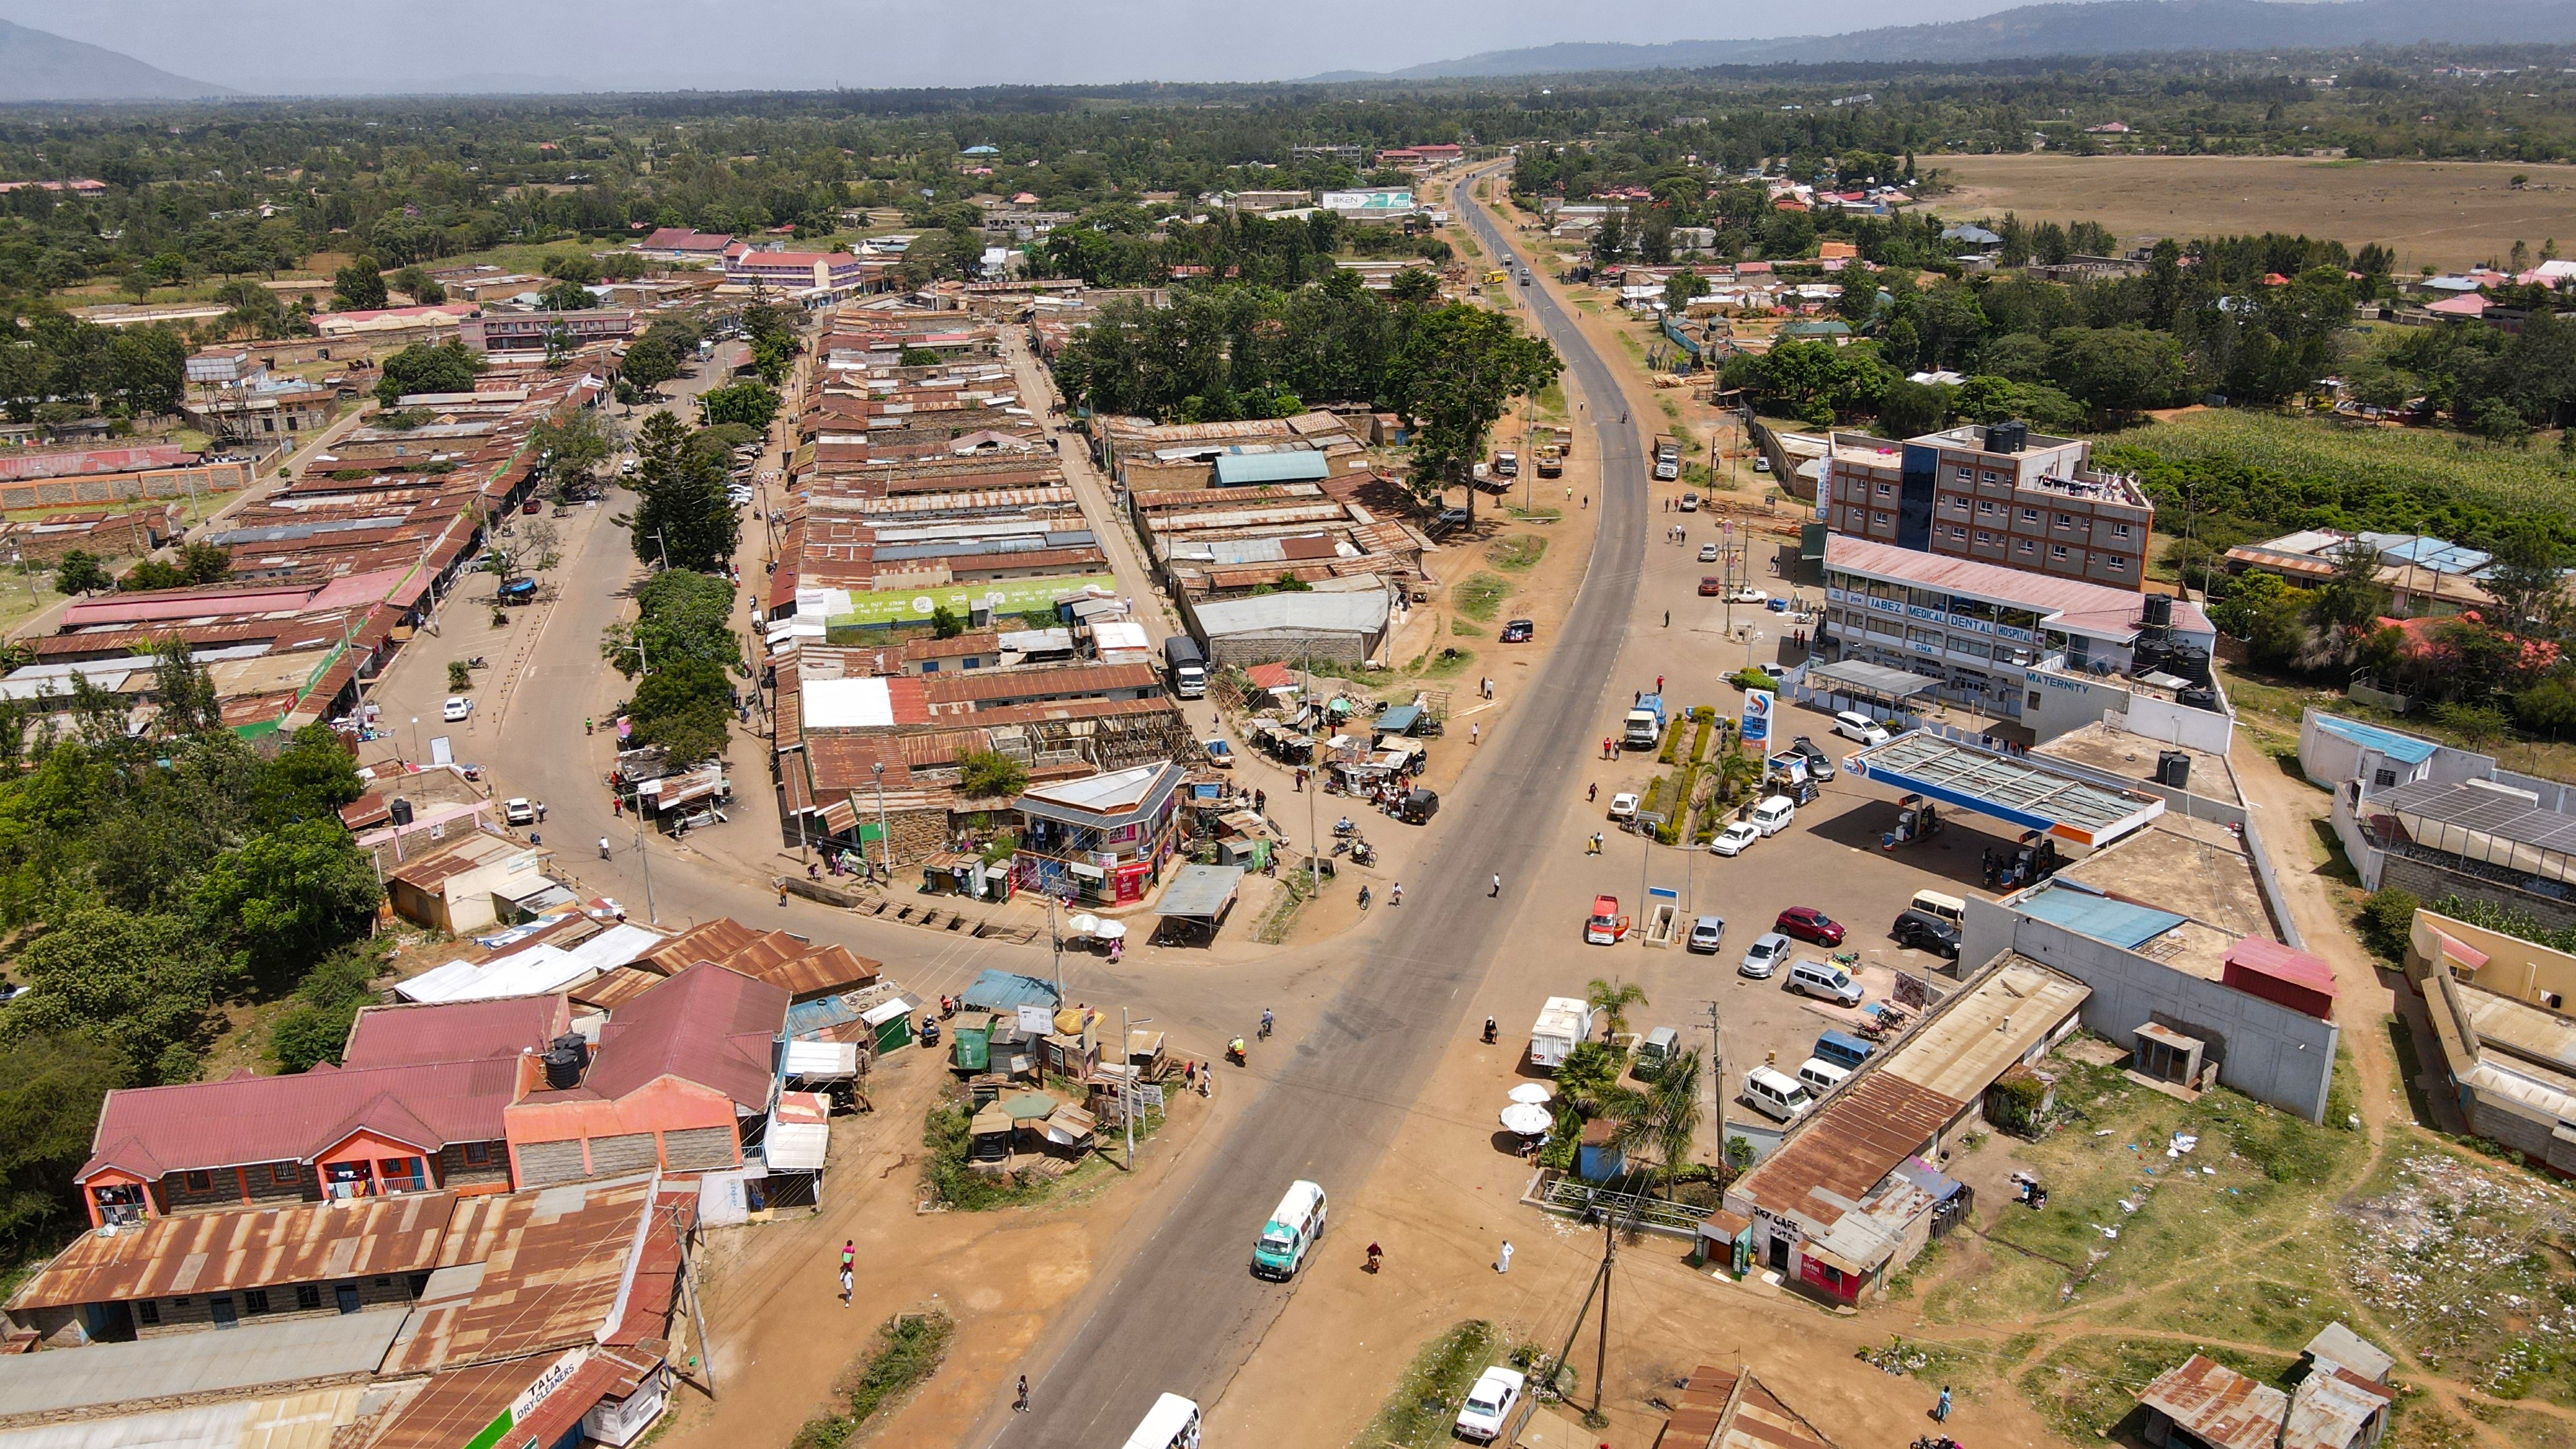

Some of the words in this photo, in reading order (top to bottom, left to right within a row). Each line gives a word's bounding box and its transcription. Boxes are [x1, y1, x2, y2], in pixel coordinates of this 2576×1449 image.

[1871, 598, 1901, 612] JABEZ
[1908, 606, 1945, 623] MEDICAL
[1951, 616, 1993, 634] DENTAL
[1998, 625, 2031, 642] HOSPITAL
[1915, 644, 1932, 654] SHA
[2026, 672, 2089, 694] MATERNITY
[1753, 1206, 1771, 1220] SKY
[1774, 1215, 1798, 1233] CAFE
[1770, 1226, 1798, 1242] HOTEL
[517, 1363, 574, 1419] DRY-CLEANERS
[527, 1365, 561, 1396] TALA
